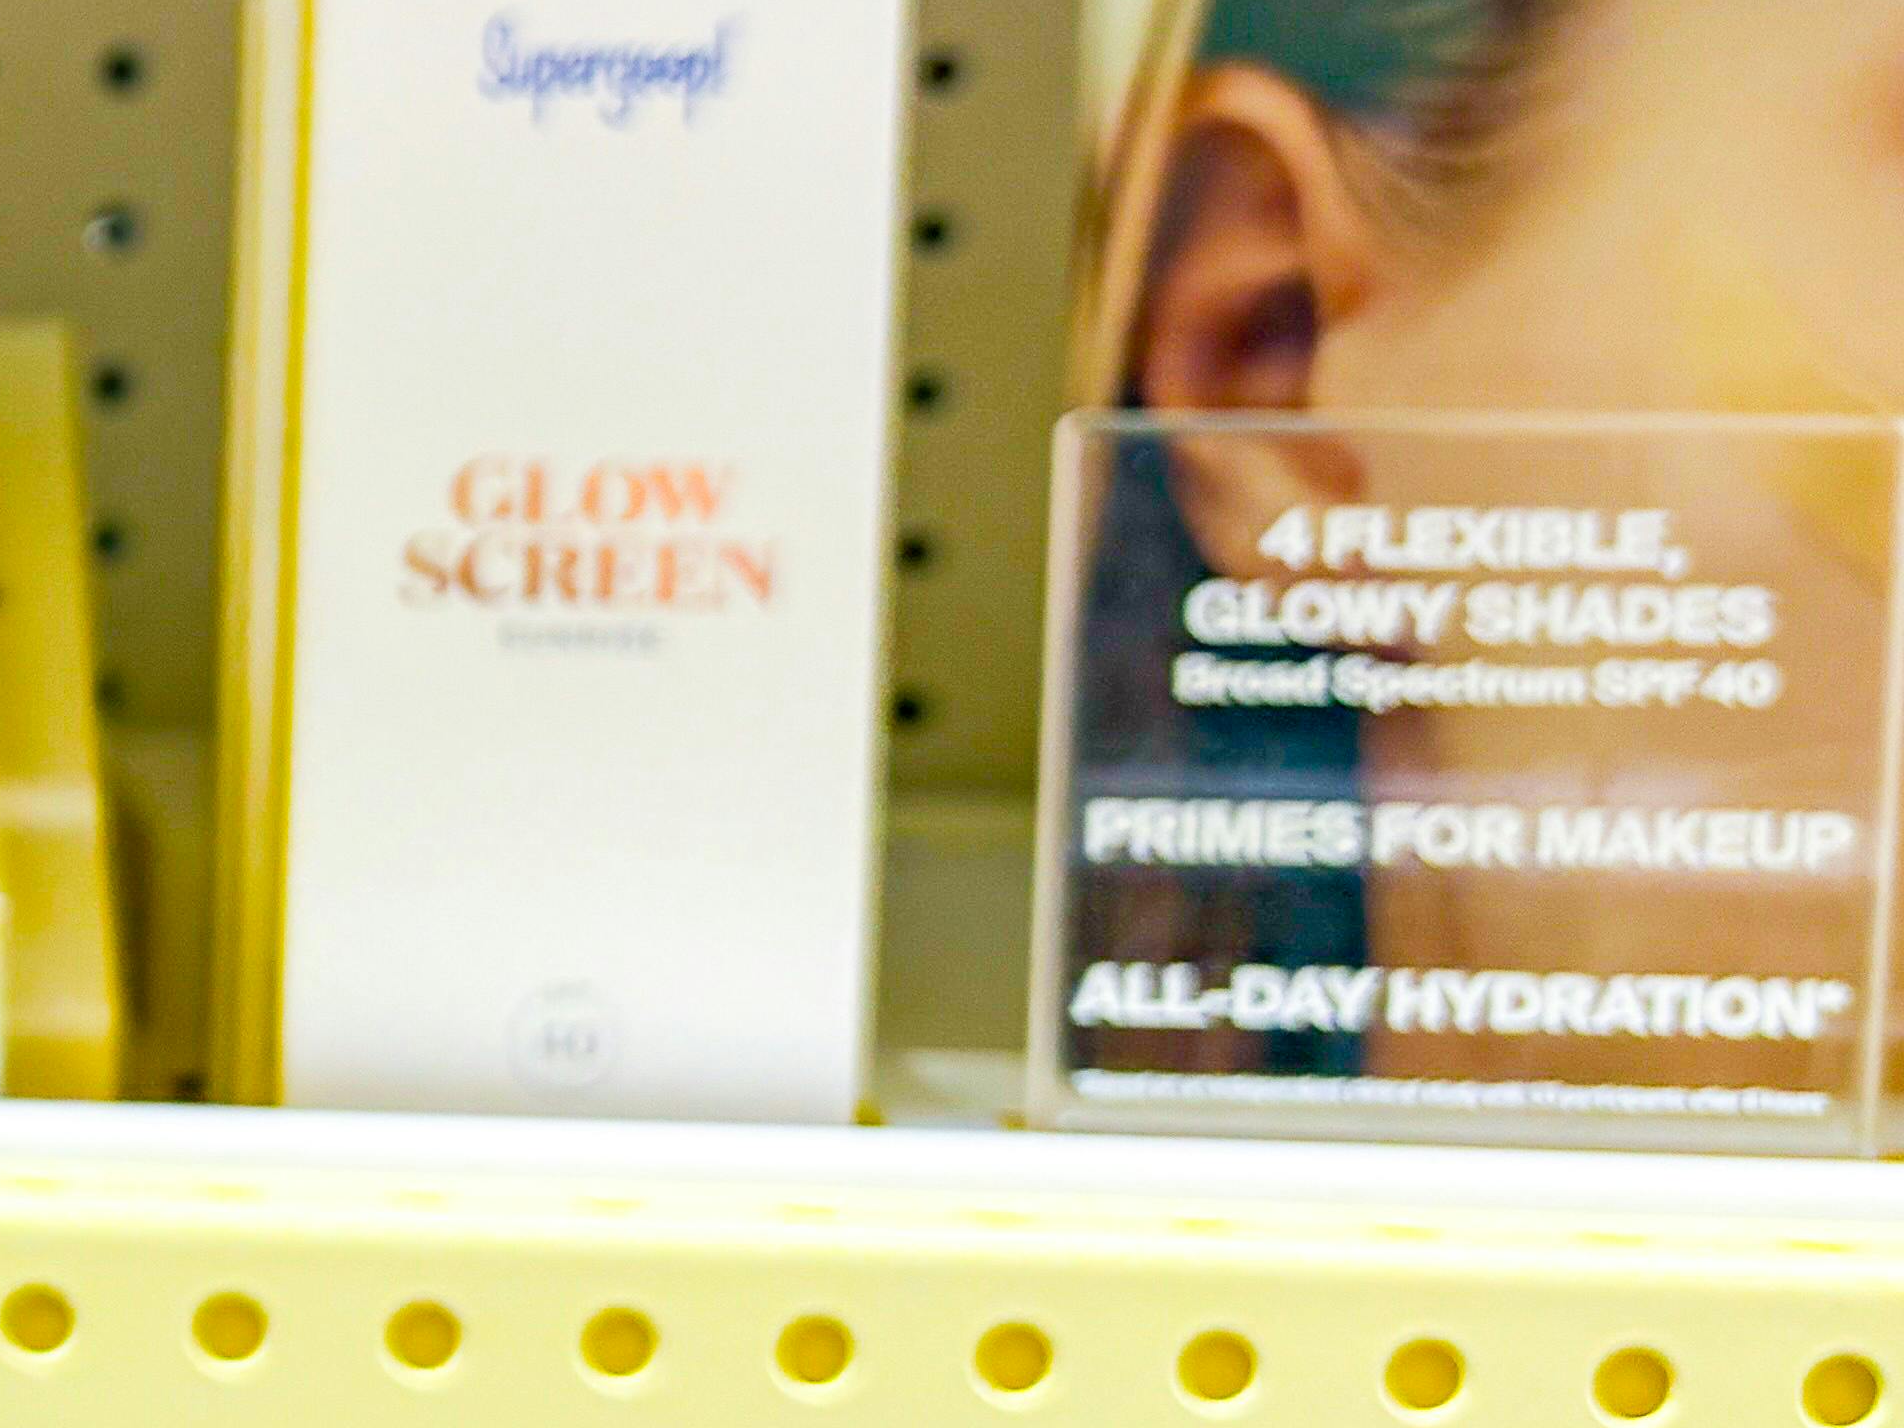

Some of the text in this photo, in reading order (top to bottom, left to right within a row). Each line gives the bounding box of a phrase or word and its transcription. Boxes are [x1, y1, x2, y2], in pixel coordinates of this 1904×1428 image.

[449, 452, 737, 526] GLOW
[398, 528, 780, 614] SCREEN
[1259, 506, 1689, 576] 4 FLEXIBLE,
[1183, 579, 1778, 647] GLOWY SHADES
[1173, 652, 1780, 714] Broad Spectrum SPF 40
[1084, 797, 1856, 872] PRIMES FOR MAKEUP
[1069, 961, 1379, 1033] ALL-DAY
